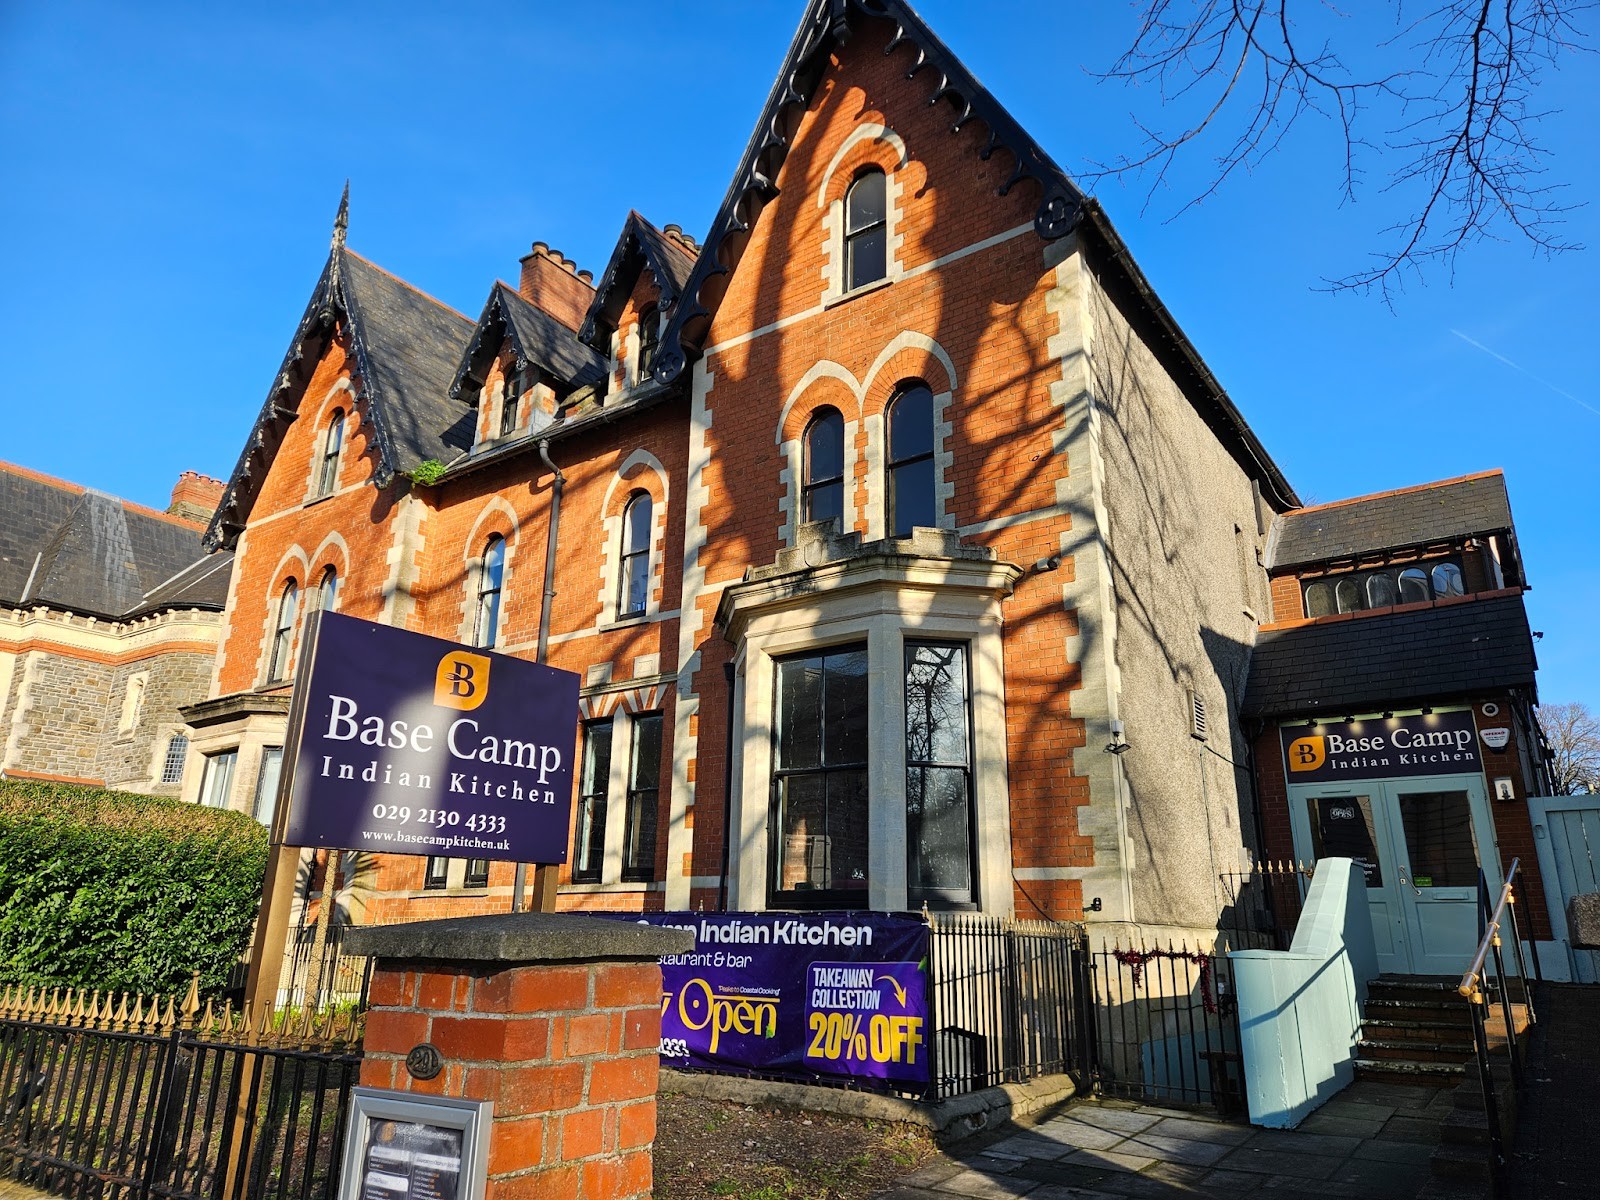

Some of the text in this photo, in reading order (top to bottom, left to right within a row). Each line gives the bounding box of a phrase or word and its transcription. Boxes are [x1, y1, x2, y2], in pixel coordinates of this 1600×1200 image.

[323, 694, 561, 785] Base Camp
[1327, 728, 1472, 754] Base Camp
[1331, 751, 1475, 769] Indian Kitchen
[320, 756, 556, 805] Indian Kitchen
[372, 803, 507, 834] 029 2130 4333
[362, 829, 511, 851] www.basecampkitchen.uk
[699, 919, 770, 944] Indian
[773, 920, 872, 946] Kitchen
[656, 951, 753, 968] staurant & bar
[812, 967, 874, 988] TAKEAWAY
[811, 988, 881, 1010] COLLECTION
[678, 978, 777, 1054] Open
[806, 1012, 923, 1065] 20% OFF
